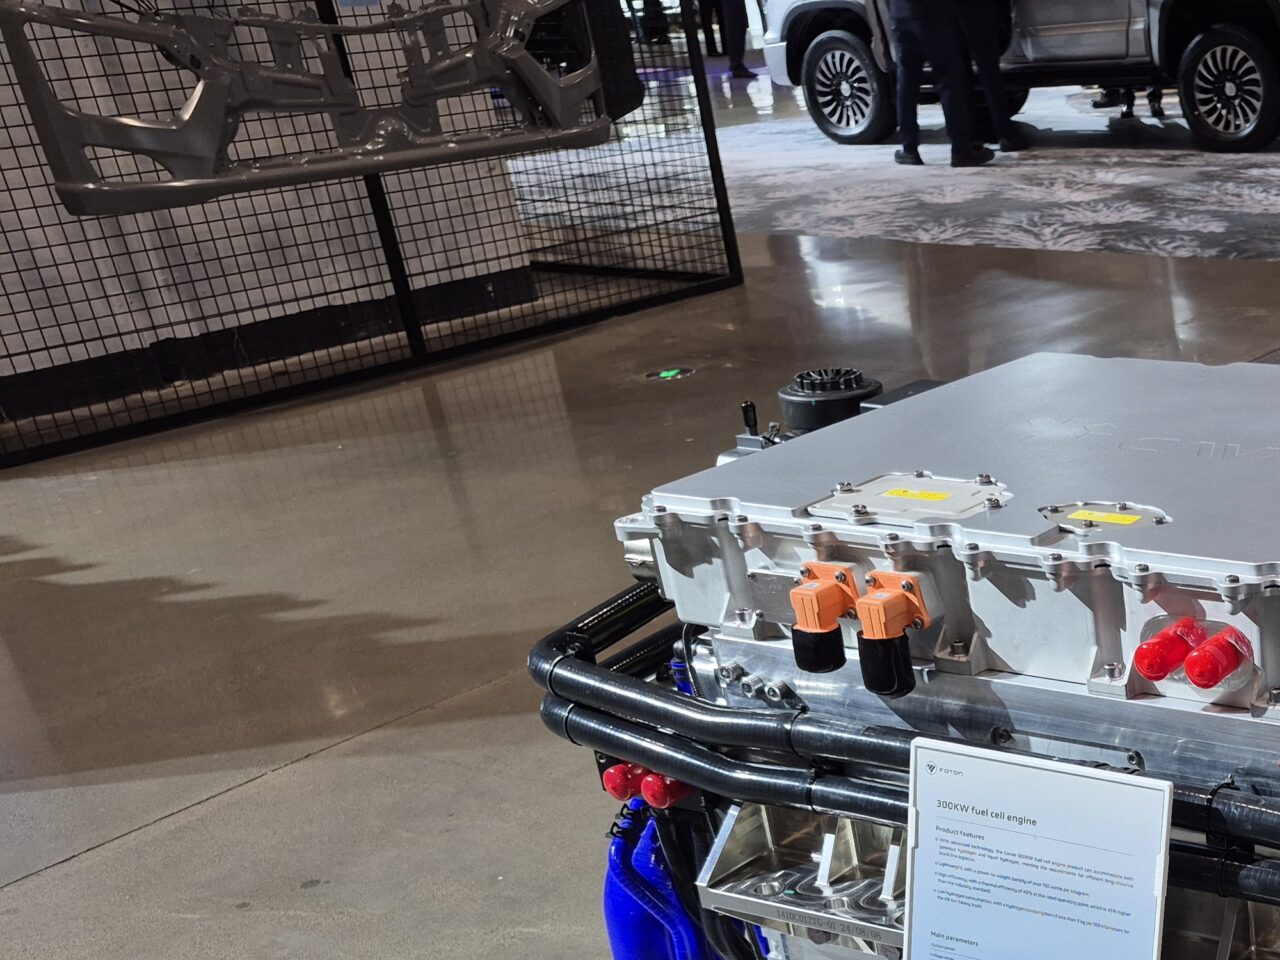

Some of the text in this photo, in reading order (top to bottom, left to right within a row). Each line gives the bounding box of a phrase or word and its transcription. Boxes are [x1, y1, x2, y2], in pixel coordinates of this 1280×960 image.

[936, 799, 1037, 828] 300KW fuel cell engine
[935, 825, 984, 841] Product features
[930, 930, 978, 948] Main parameters
